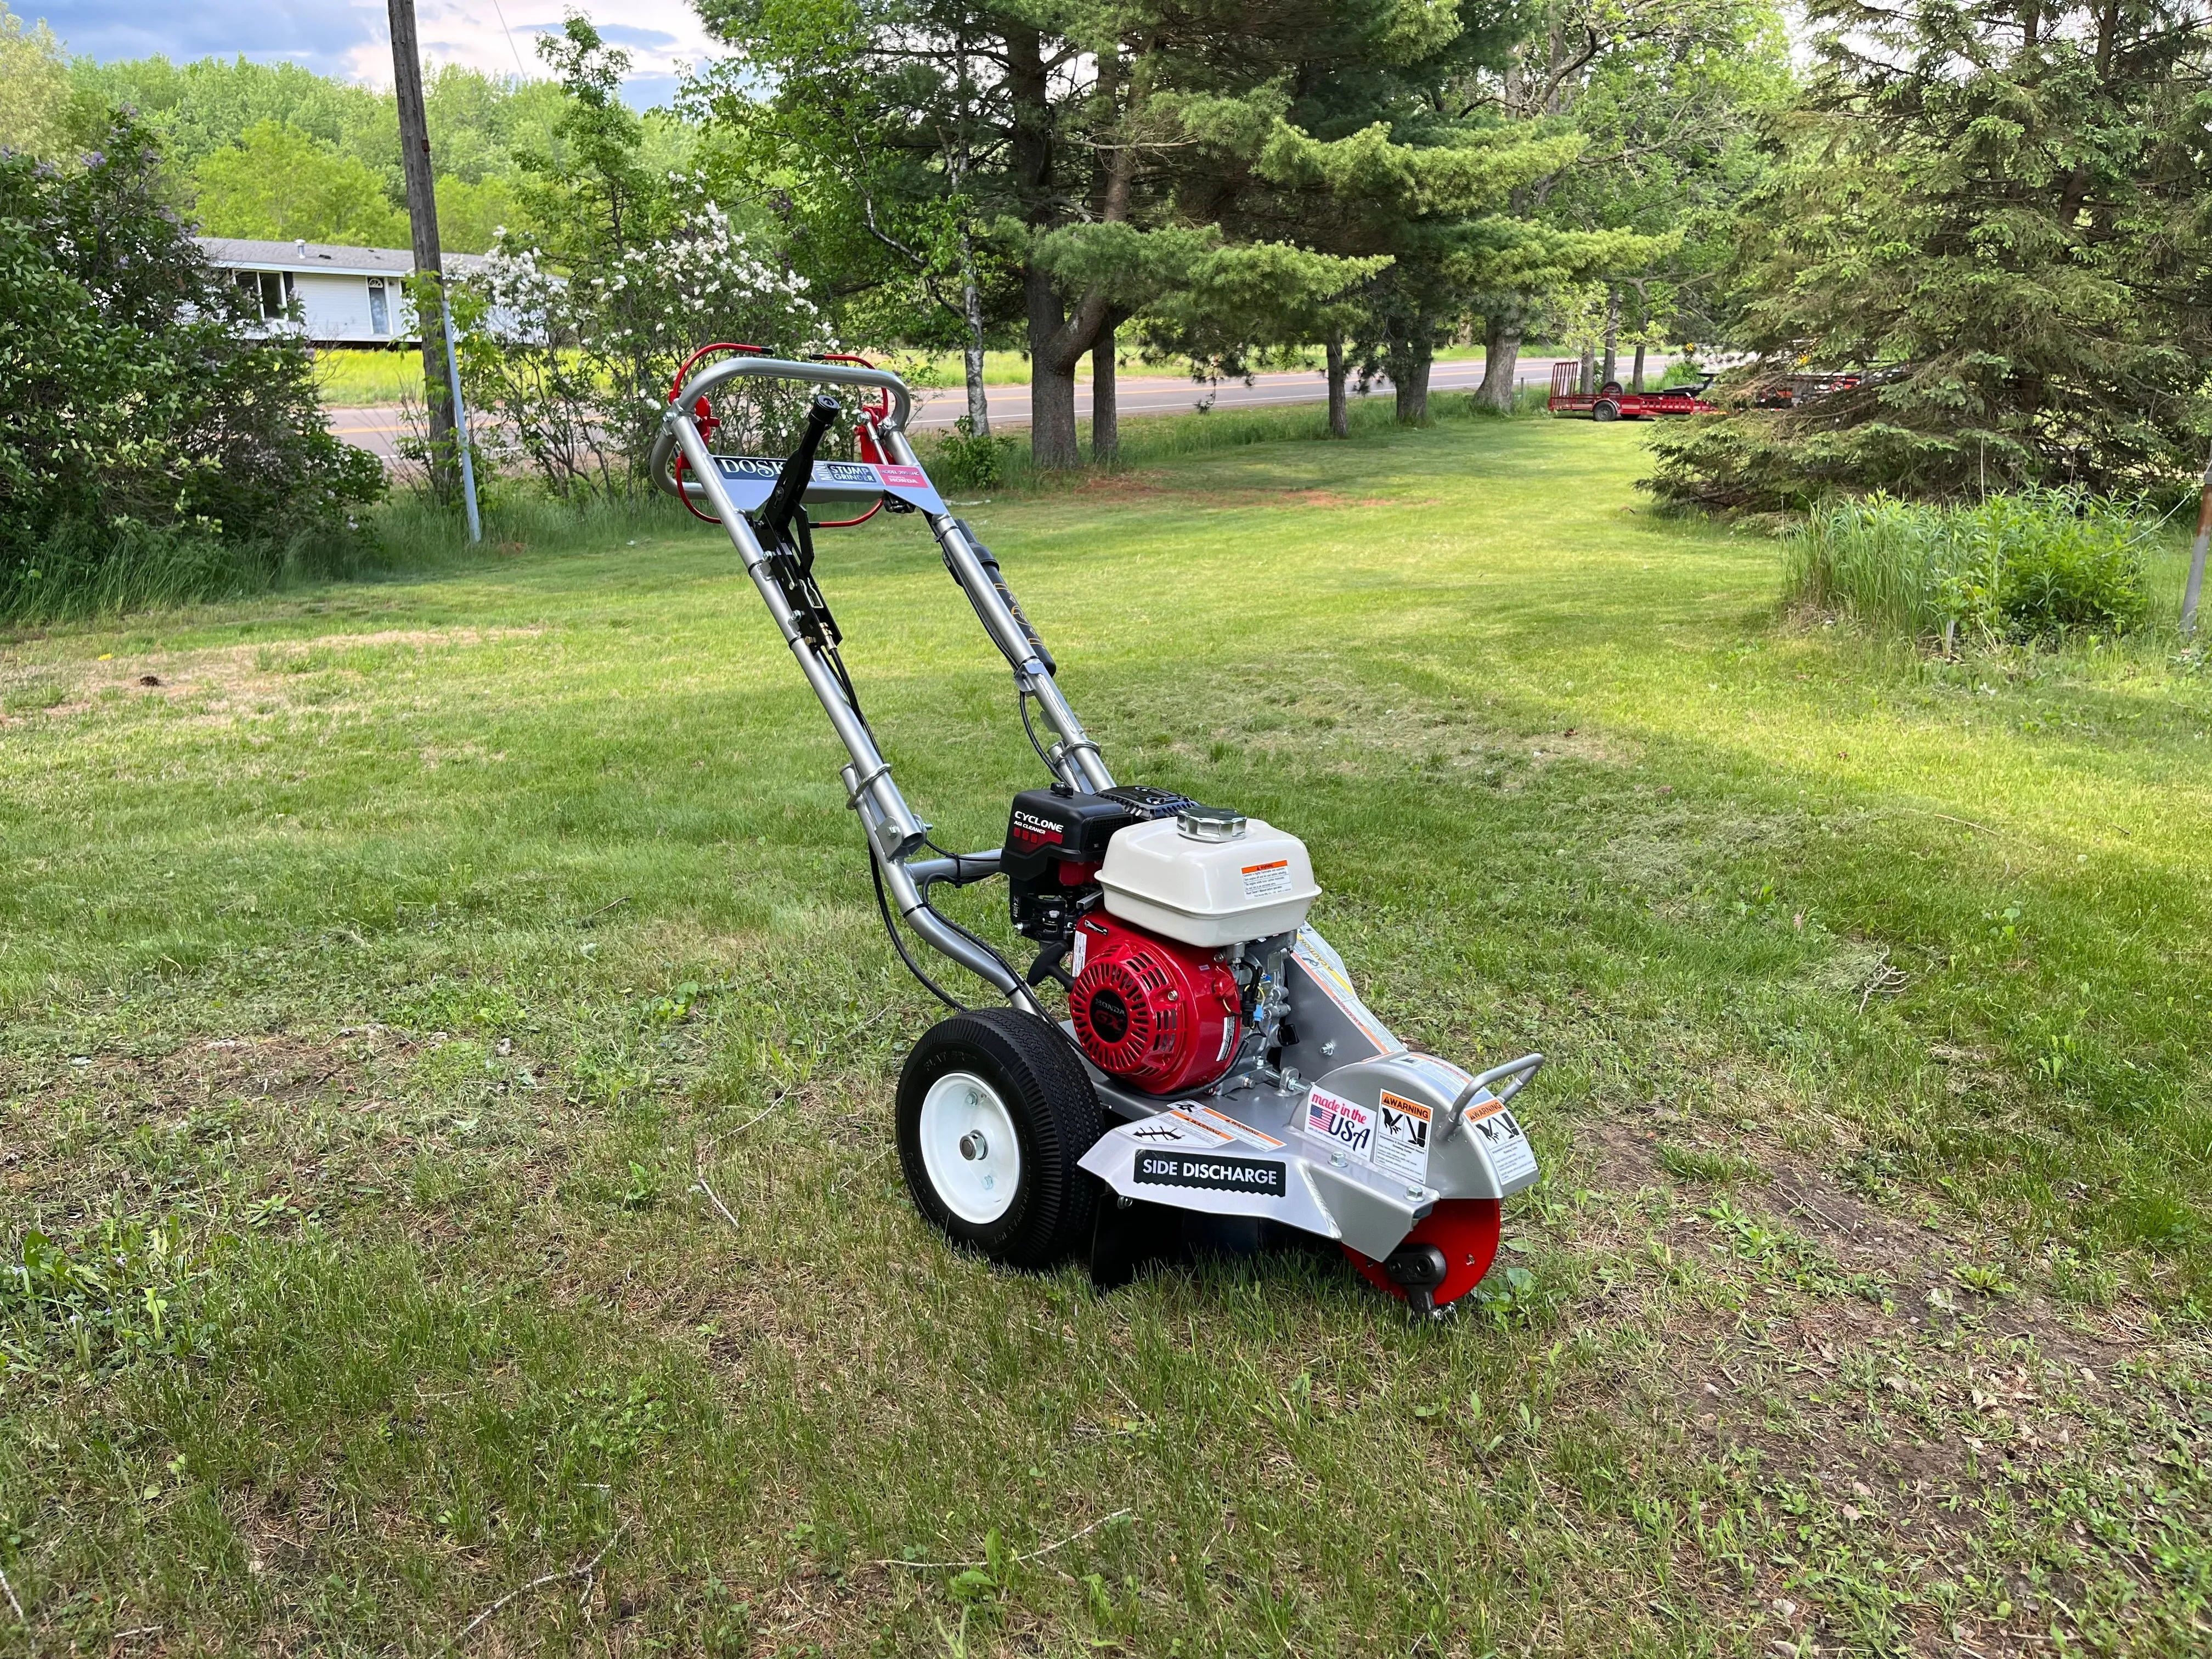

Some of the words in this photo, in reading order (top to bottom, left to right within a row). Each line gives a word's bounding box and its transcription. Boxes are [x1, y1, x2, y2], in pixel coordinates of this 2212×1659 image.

[830, 466, 869, 475] STUMP
[1014, 810, 1064, 833] CYCLONE
[1023, 823, 1046, 834] CLEANER
[1299, 938, 1328, 966] CAUTION
[1094, 998, 1126, 1017] HONDA
[1311, 1093, 1340, 1113] made
[1340, 1103, 1350, 1118] in
[1351, 1108, 1367, 1124] the
[1390, 1097, 1429, 1119] WARNING
[1473, 1102, 1502, 1119] WARNING
[1328, 1114, 1370, 1152] USA
[1143, 1159, 1178, 1176] SIDE
[1183, 1163, 1277, 1185] DISCHARGE
